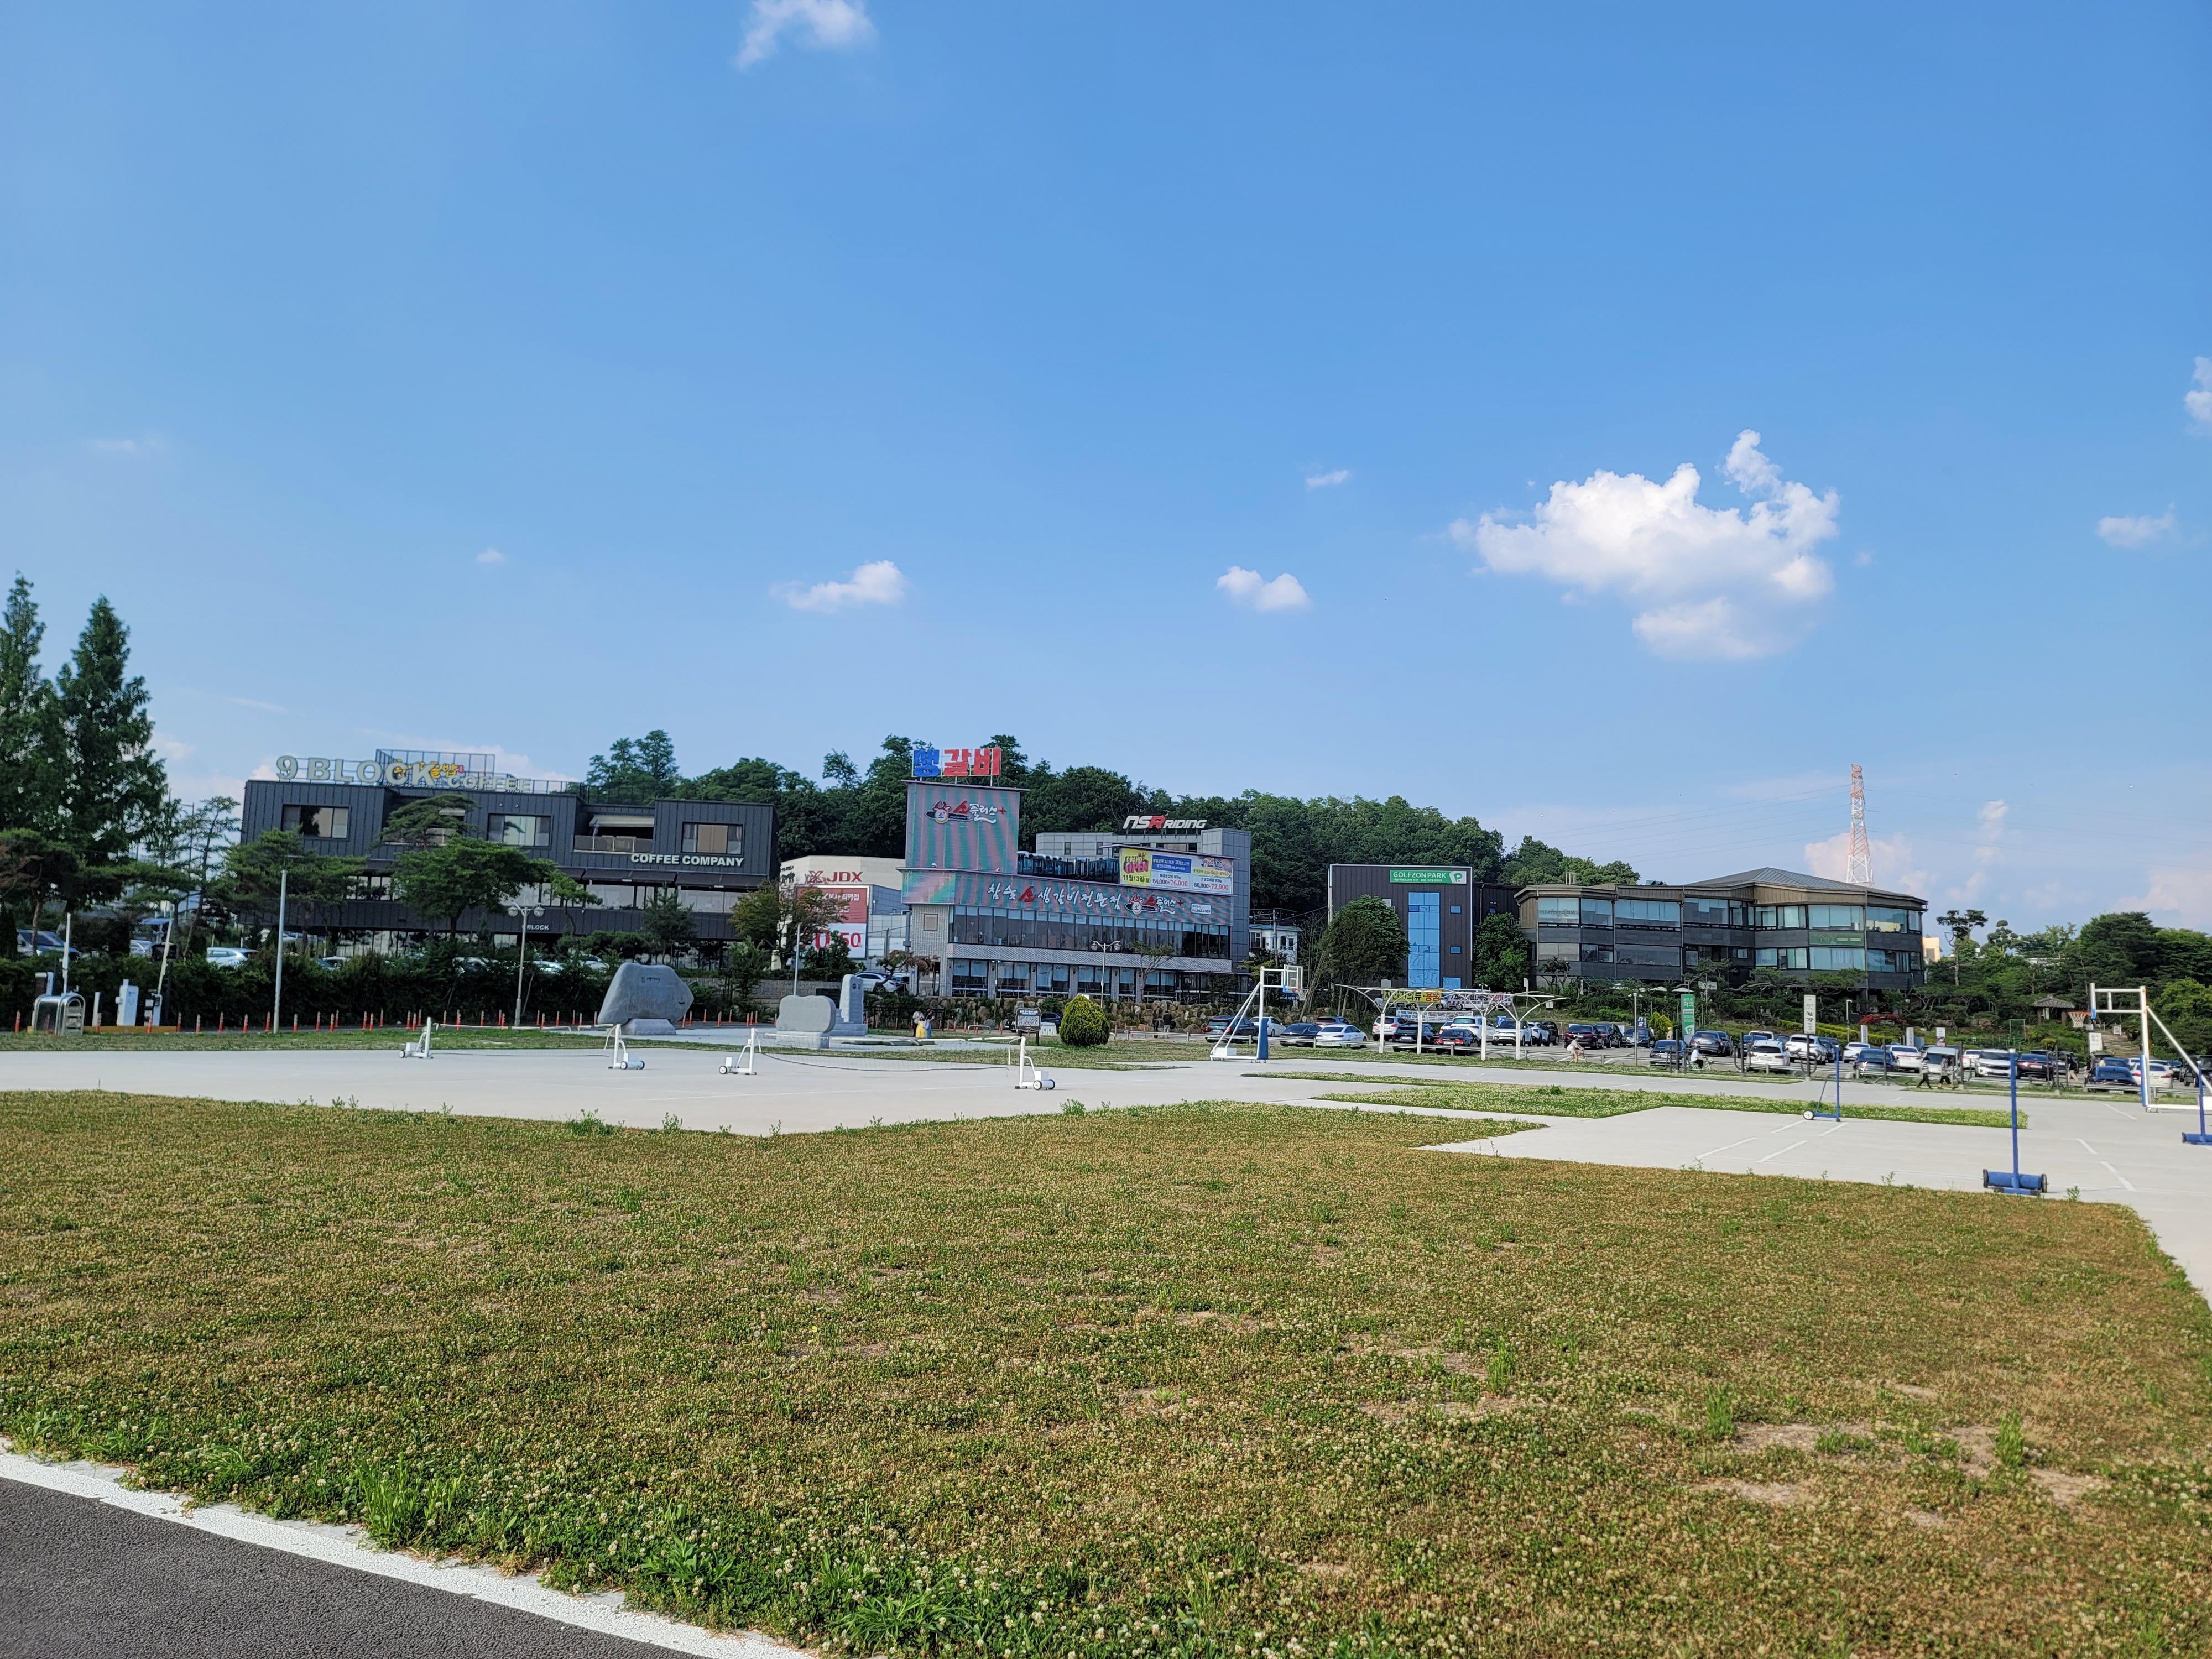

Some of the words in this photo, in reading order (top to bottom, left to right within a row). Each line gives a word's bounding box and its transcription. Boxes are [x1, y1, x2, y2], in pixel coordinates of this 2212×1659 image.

[276, 755, 298, 779] 9
[307, 757, 436, 788] BLOCK
[447, 775, 533, 793] COFFEE
[1163, 820, 1207, 828] RIDING
[630, 853, 679, 864] COFFEE
[682, 855, 744, 867] COMPANY
[1124, 860, 1149, 874] OPEN
[827, 872, 863, 882] JDX
